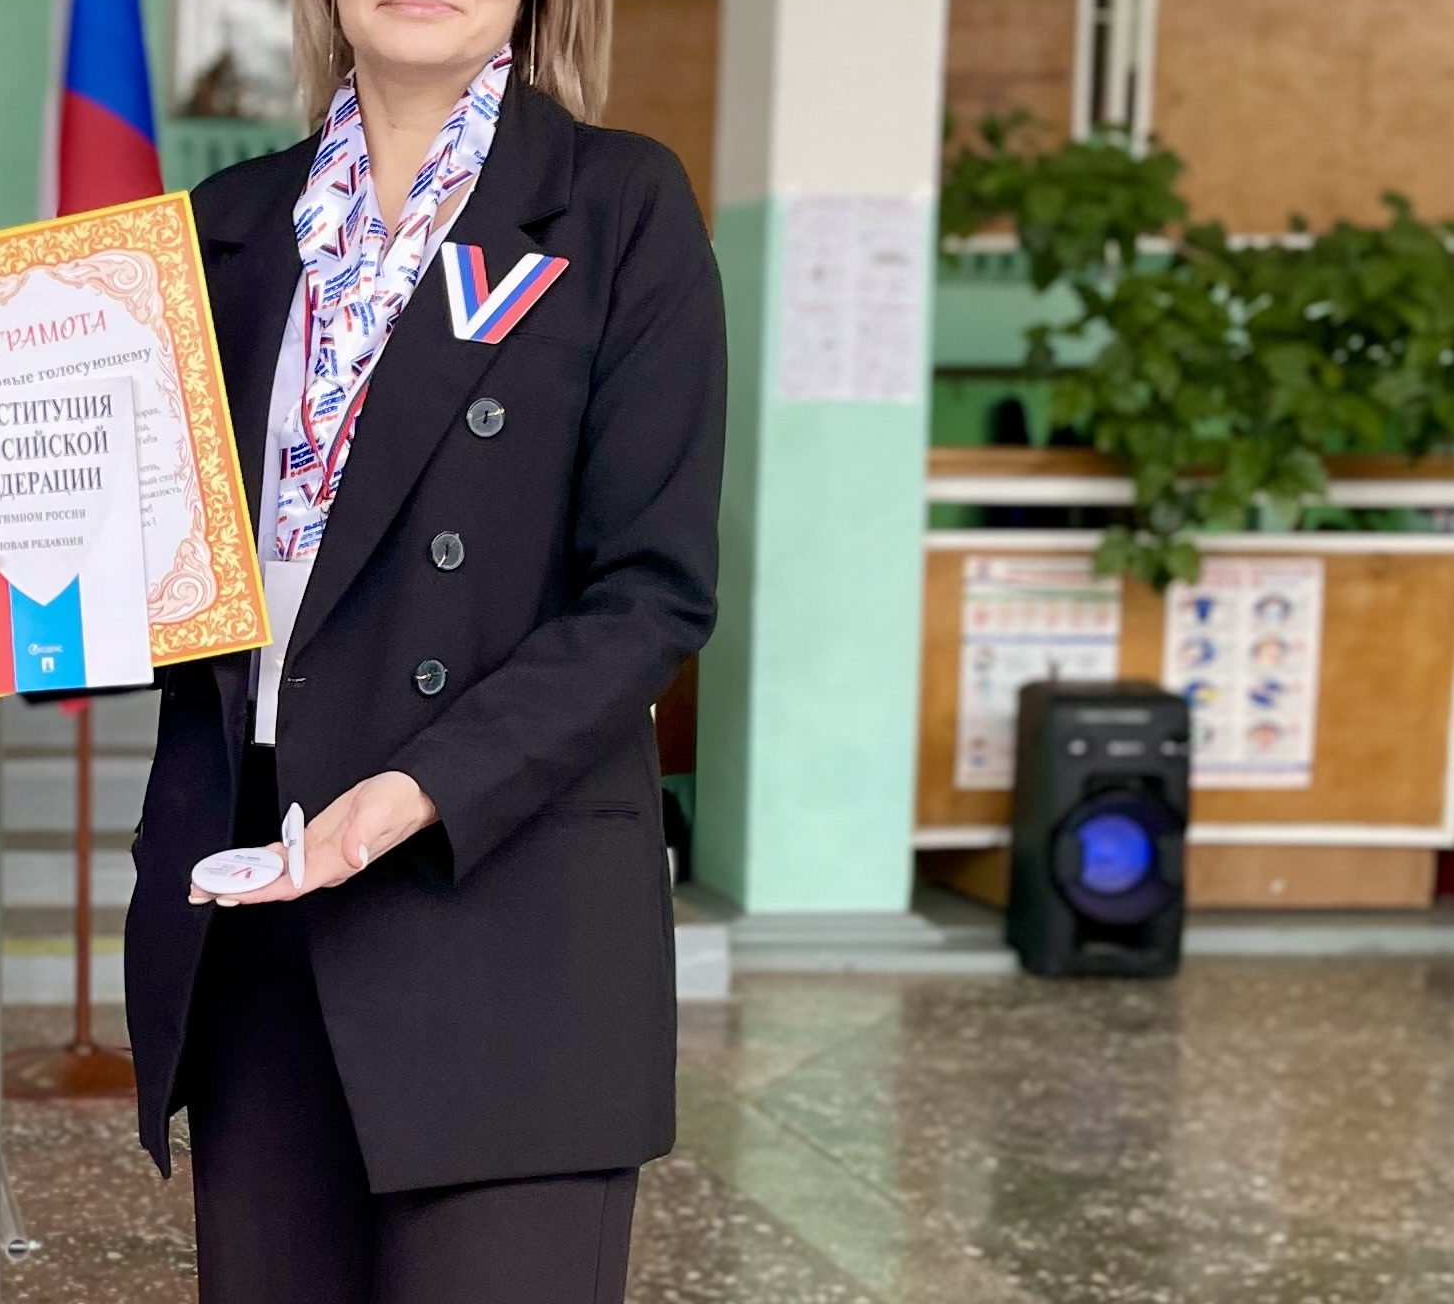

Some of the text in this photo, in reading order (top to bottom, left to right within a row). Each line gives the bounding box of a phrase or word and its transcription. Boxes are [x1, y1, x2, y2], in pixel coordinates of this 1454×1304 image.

[38, 347, 152, 382] голосующему
[45, 508, 86, 522] РОССИИ
[31, 535, 84, 549] РЕДАКЦИЯ
